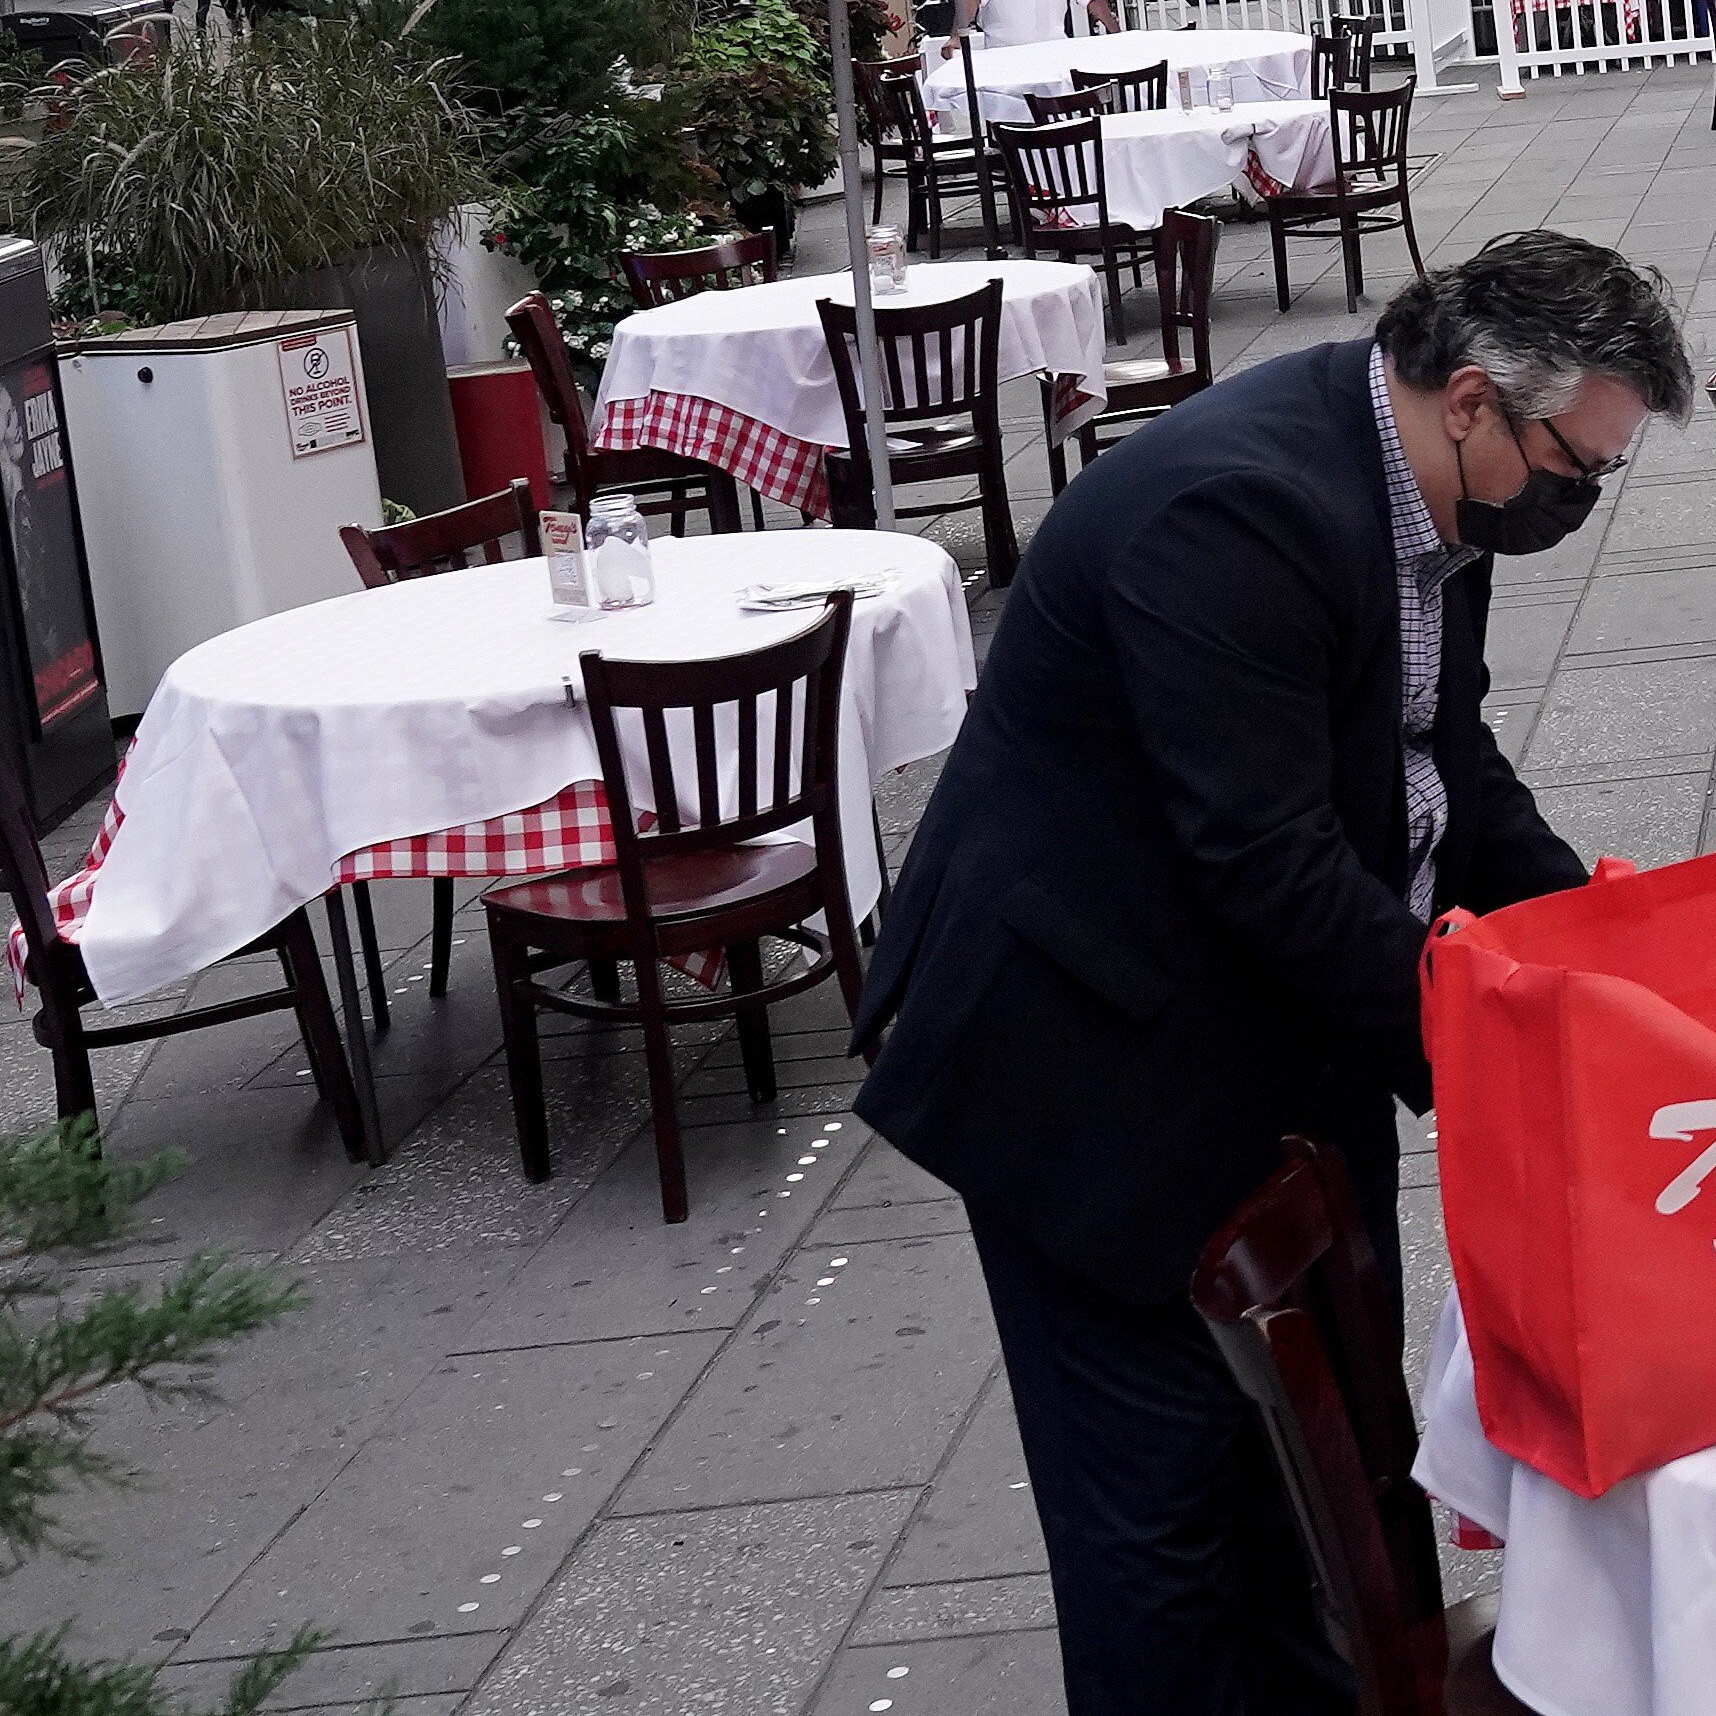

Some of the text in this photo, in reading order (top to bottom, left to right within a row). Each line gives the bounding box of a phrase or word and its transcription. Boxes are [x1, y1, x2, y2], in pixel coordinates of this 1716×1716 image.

[289, 376, 350, 397] NO ALCOHOL
[291, 403, 316, 416] THIS
